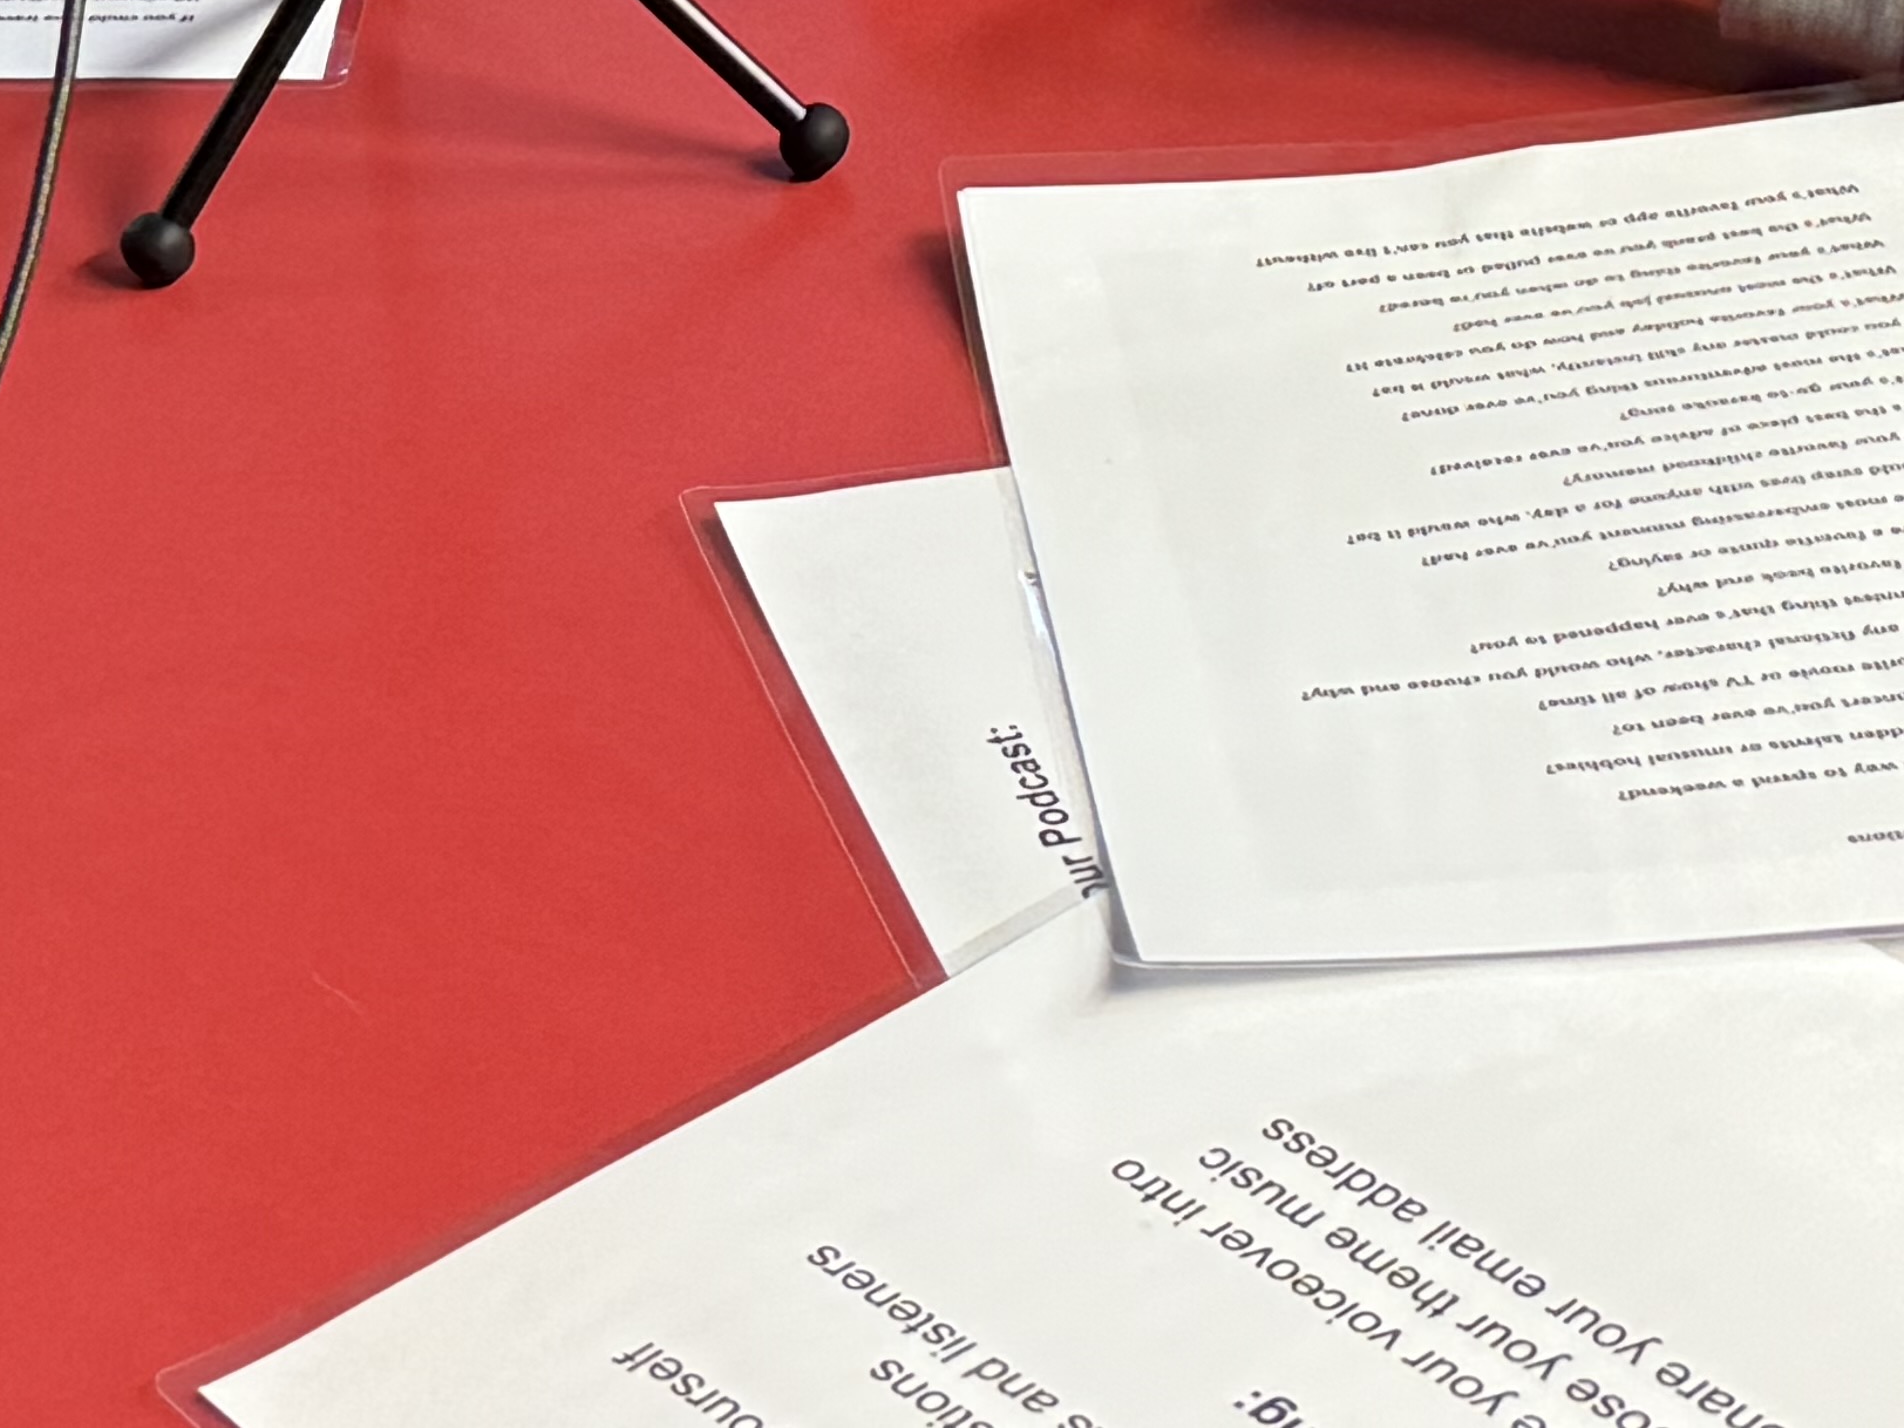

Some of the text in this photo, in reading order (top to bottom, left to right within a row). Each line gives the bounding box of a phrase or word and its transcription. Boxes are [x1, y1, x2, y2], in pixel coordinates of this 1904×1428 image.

[986, 724, 1083, 847] Podcast:
[1198, 1147, 1326, 1229] music
[806, 1245, 1060, 1414] and listeners
[1111, 1159, 1520, 1417] your voiceover intro
[1261, 1118, 1784, 1428] hare your email address
[1324, 1226, 1461, 1319] theme
[1455, 1314, 1574, 1382] your
